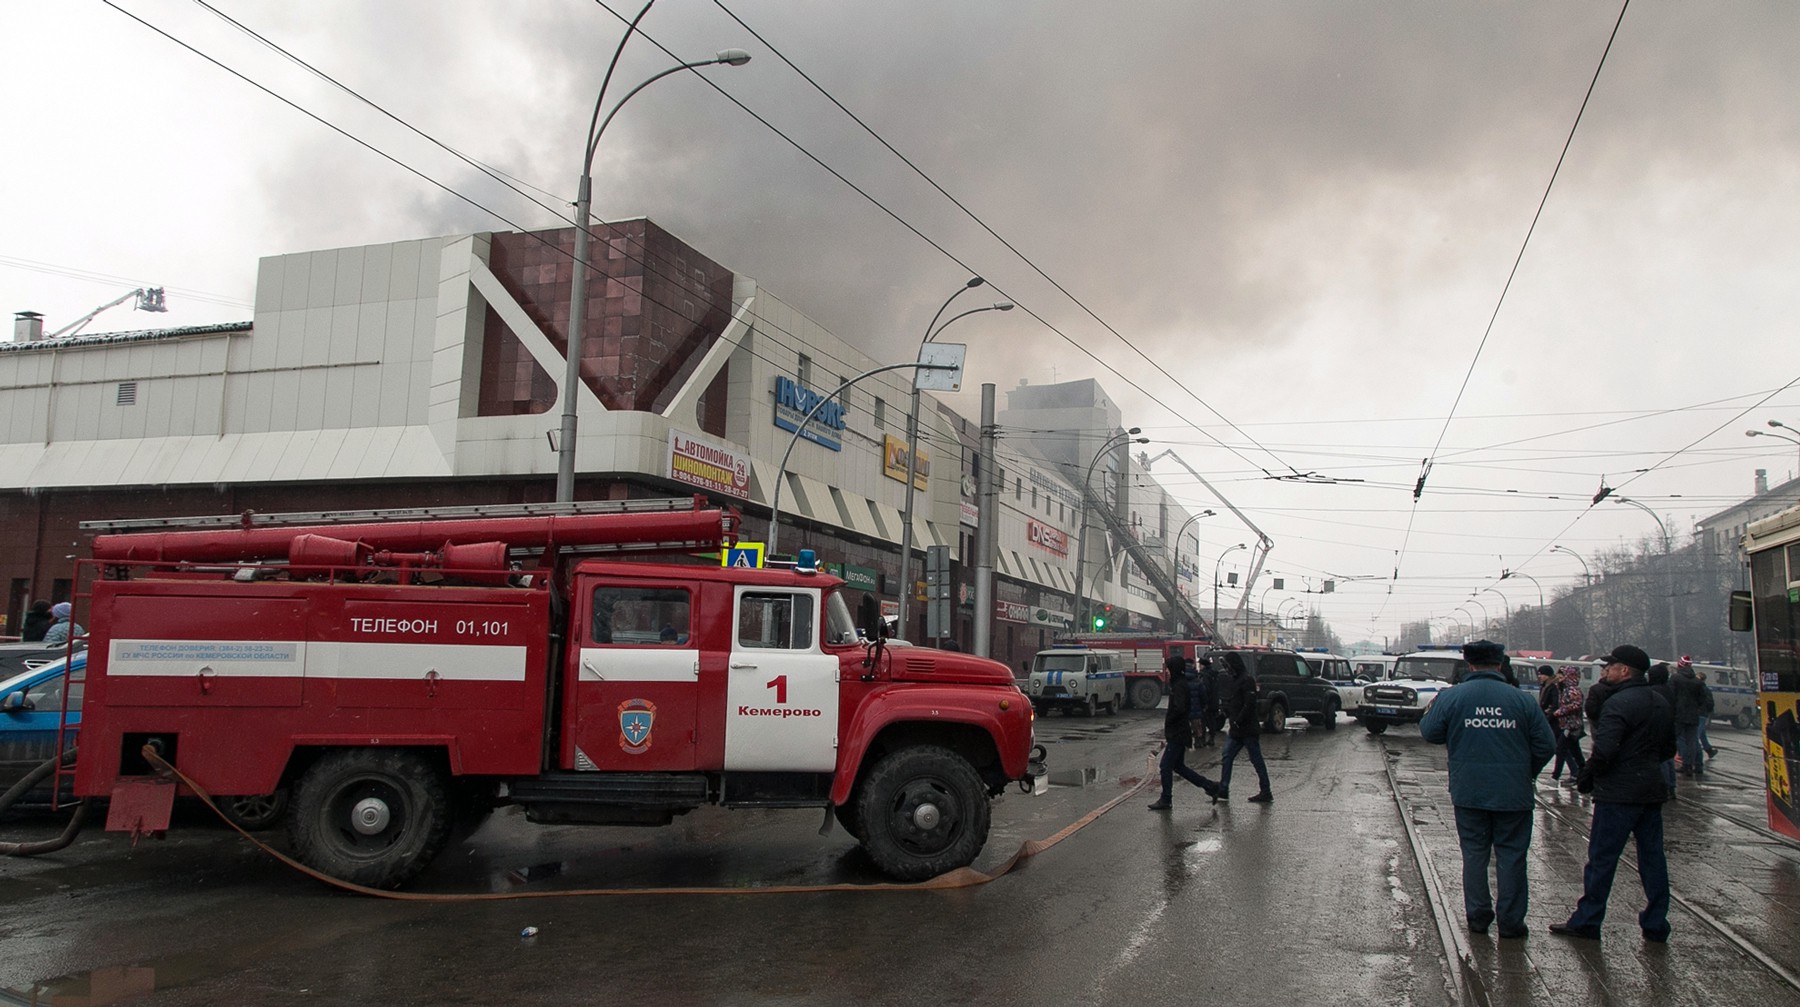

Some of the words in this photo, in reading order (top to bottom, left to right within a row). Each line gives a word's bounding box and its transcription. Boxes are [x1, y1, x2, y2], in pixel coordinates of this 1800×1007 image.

[683, 440, 733, 469] АВТОМОЙКА
[673, 453, 733, 486] ШИНОМОНТАЖ
[736, 463, 745, 477] 24
[350, 618, 438, 634] ТЕЛЕФОН
[456, 619, 509, 637] 01,101
[140, 644, 176, 652] ТЕЛЕФОН
[151, 652, 184, 660] РОССИИ
[766, 674, 787, 704] 1
[738, 705, 822, 719] Кемерово
[1475, 706, 1503, 716] МЧС
[1464, 718, 1517, 729] РОССИИ
